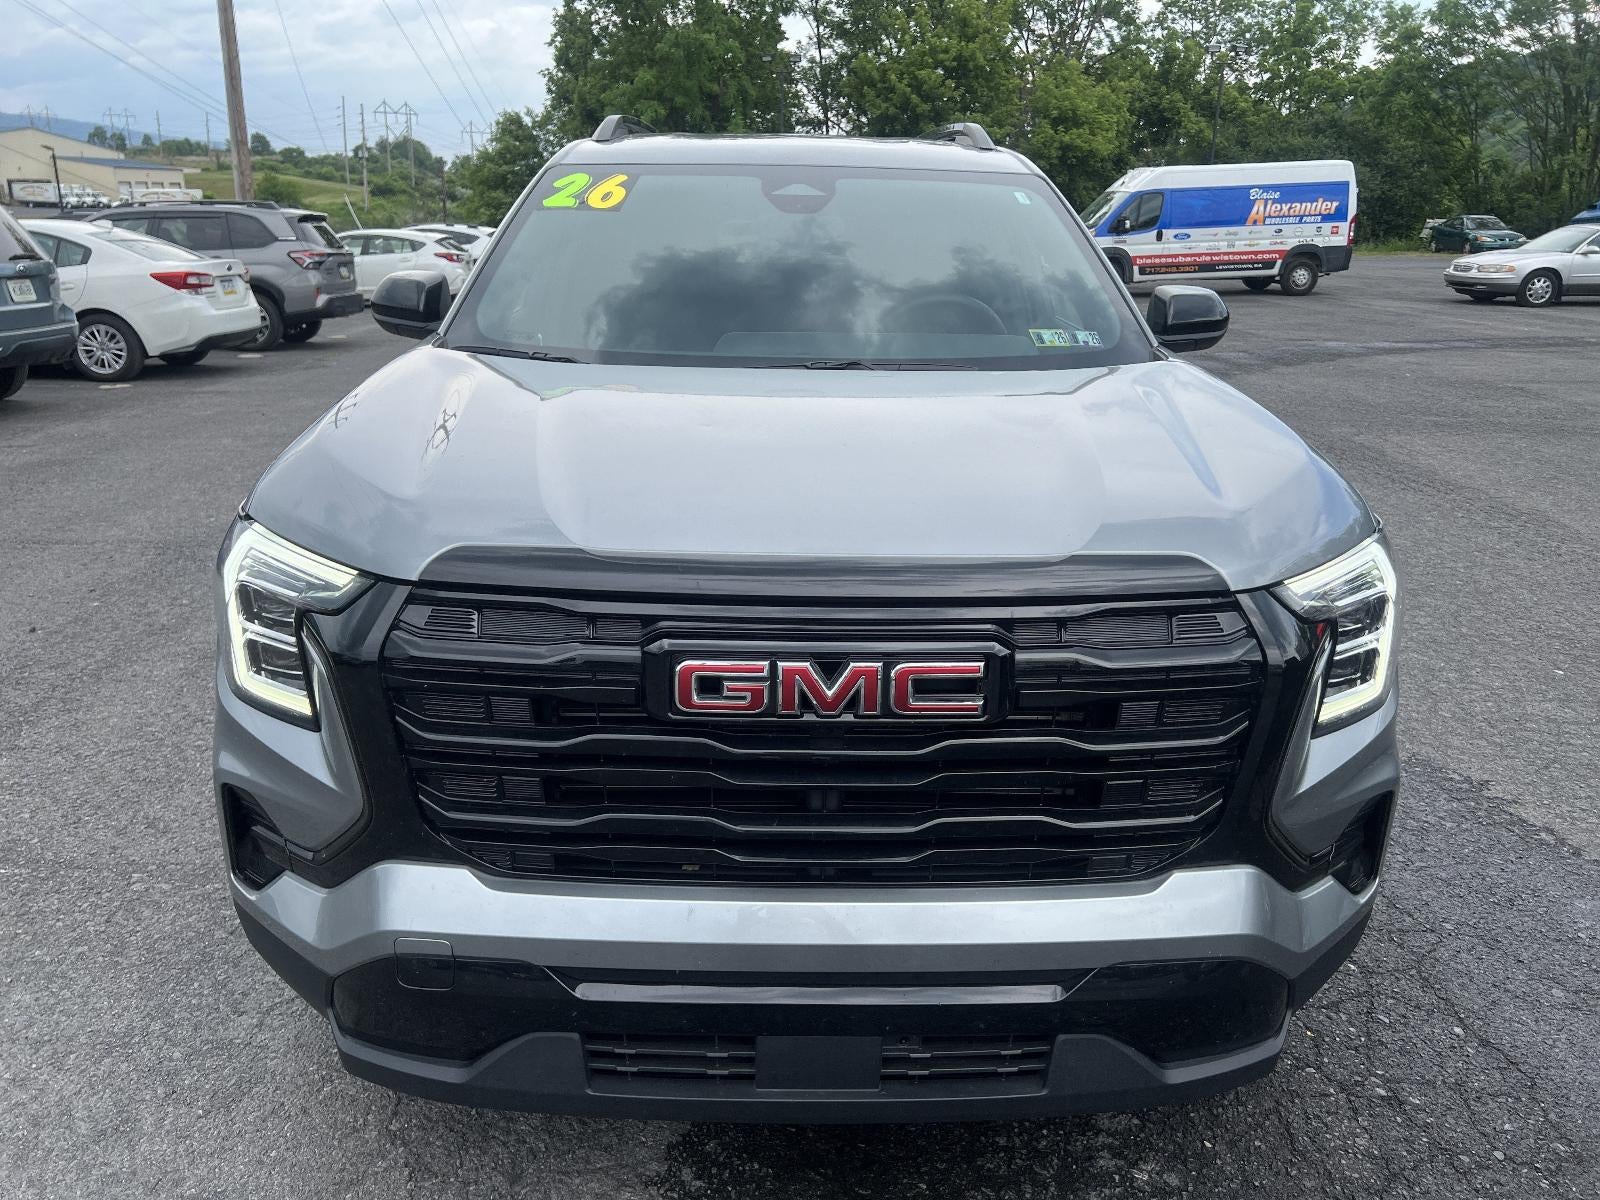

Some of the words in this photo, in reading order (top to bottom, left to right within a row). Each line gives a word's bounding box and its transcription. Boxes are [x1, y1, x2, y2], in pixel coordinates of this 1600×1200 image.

[542, 173, 628, 209] 26
[1249, 188, 1280, 199] Blaise
[1245, 198, 1340, 225] Alexander
[1264, 216, 1300, 225] WHOLESALE
[1302, 215, 1322, 223] PARTS
[675, 659, 985, 715] GMC
